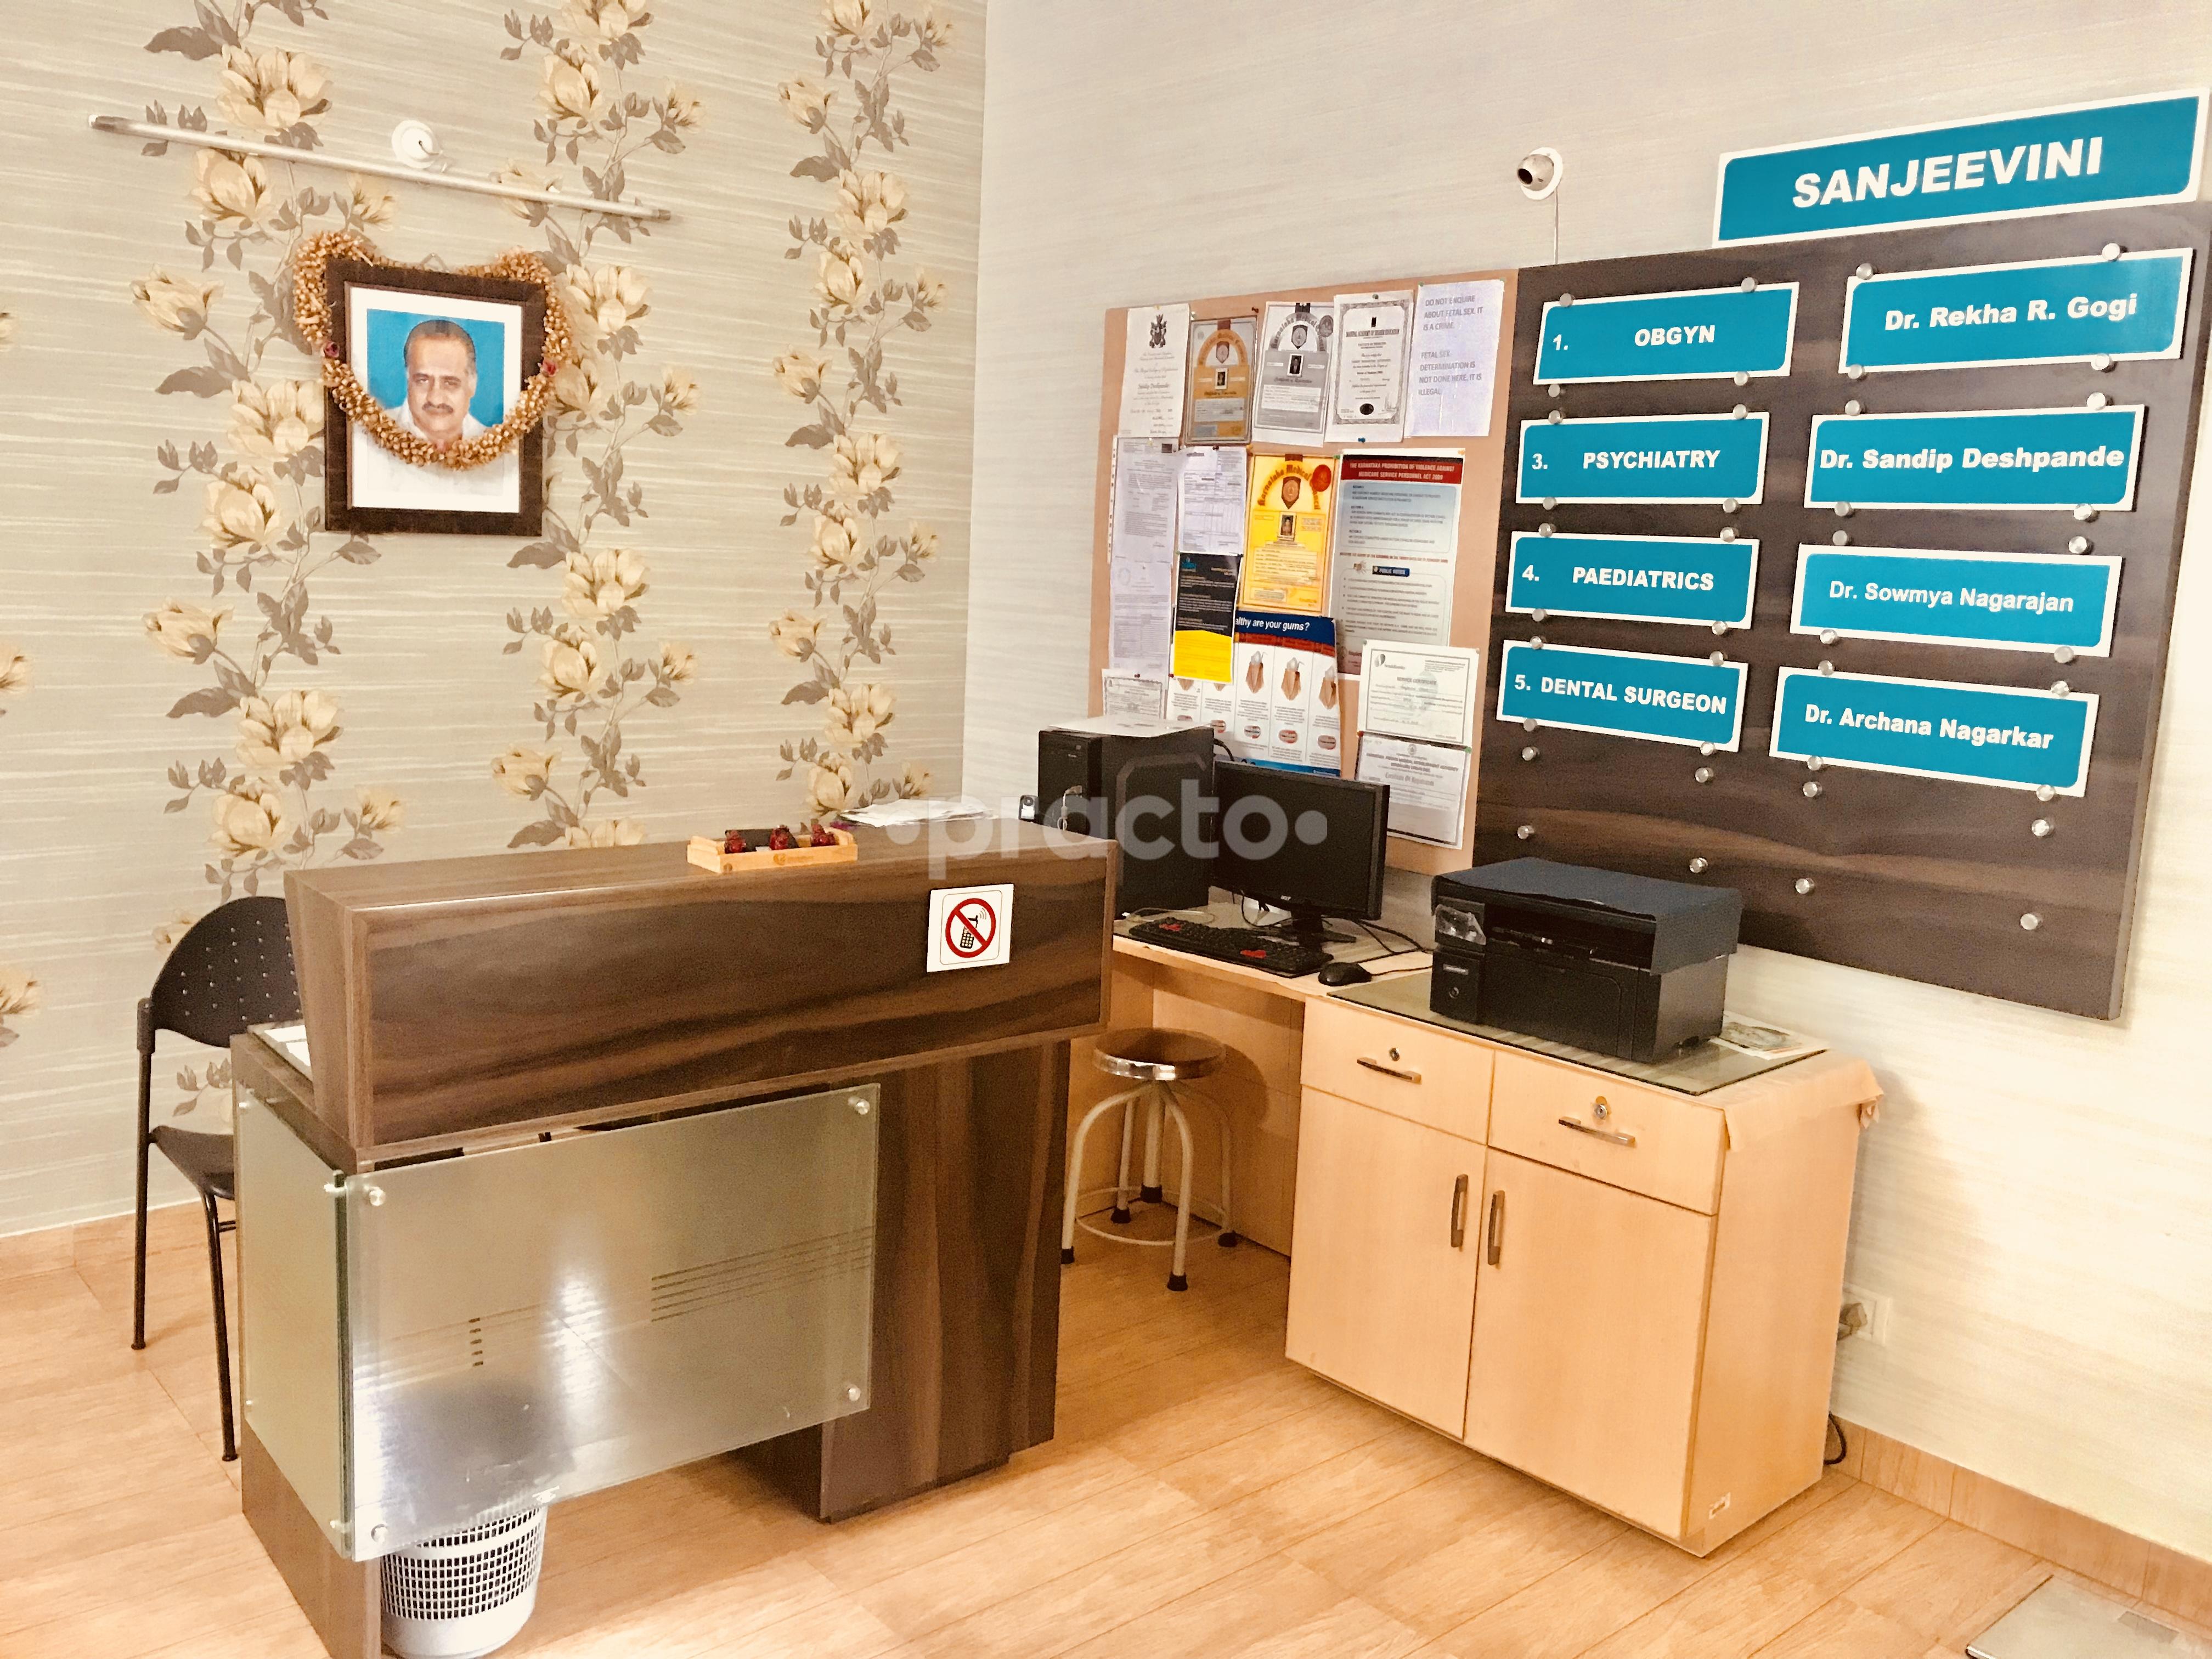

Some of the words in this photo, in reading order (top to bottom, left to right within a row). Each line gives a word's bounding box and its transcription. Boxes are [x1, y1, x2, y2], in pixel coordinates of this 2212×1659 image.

[1793, 137, 2102, 208] SANJEEVINI
[1449, 295, 1475, 304] ENQUIRE
[1885, 310, 1920, 330] Dr.
[1930, 303, 2017, 328] Rekha
[2027, 300, 2056, 321] R.
[2067, 293, 2138, 322] Gogi
[1553, 334, 1568, 351] 1.
[1635, 325, 1716, 347] OBGYN
[1420, 362, 1469, 371] DETERMINATION
[1532, 453, 1548, 470] 3.
[1583, 450, 1721, 469] PSYCHIATRY
[1820, 449, 1853, 469] Dr.
[1863, 448, 1953, 473] Sandip
[1962, 445, 2125, 472] Deshpande
[1522, 565, 1539, 582] 4.
[1572, 567, 1714, 591] PAEDIATRICS
[1830, 580, 1858, 599] Dr.
[1865, 583, 1953, 608] Sowmya
[1960, 588, 2074, 615] Nagarajan
[1265, 620, 1282, 630] your
[1283, 622, 1310, 631] gums?
[1514, 674, 1531, 691] 5.
[1541, 676, 1617, 701] DENTAL
[1624, 686, 1727, 714] SURGEON
[1804, 704, 1832, 725] Dr.
[1839, 708, 1932, 736] Archana
[1940, 719, 2054, 749] Nagarkar
